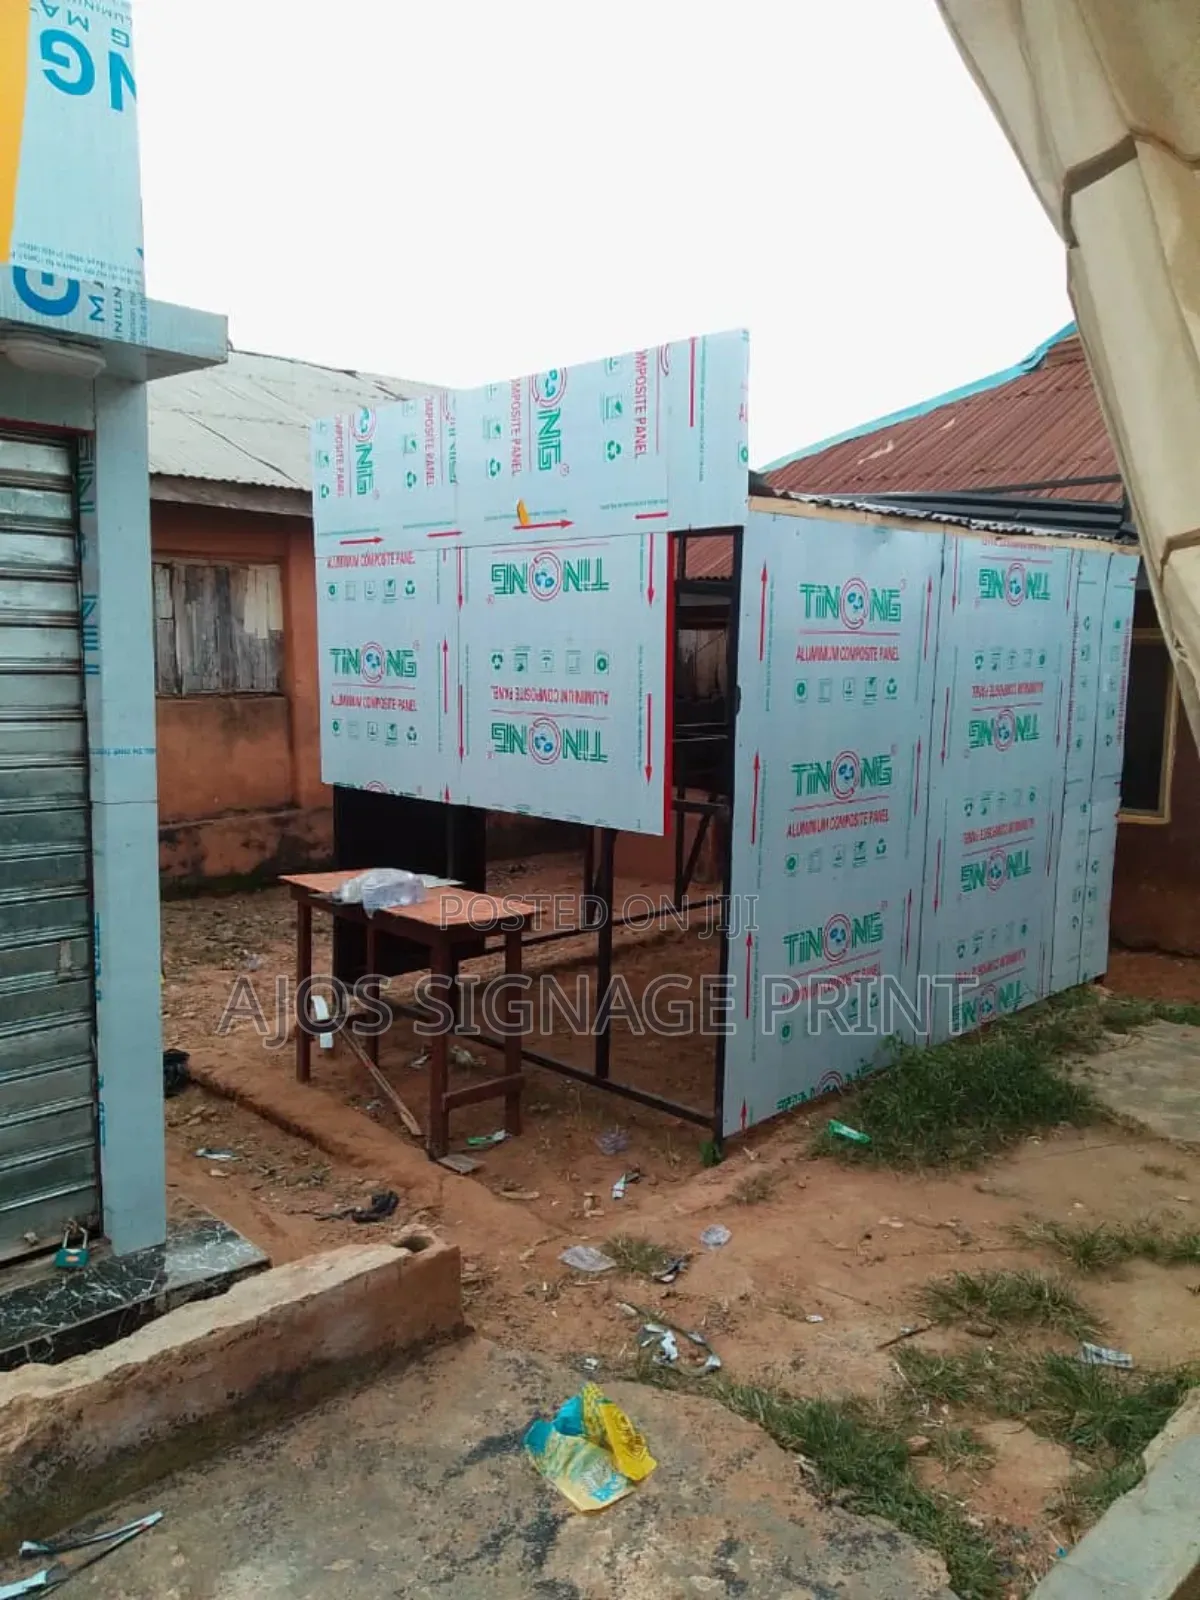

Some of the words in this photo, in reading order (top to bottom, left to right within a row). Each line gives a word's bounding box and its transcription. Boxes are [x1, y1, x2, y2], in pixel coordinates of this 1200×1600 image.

[634, 417, 648, 460] PANEL
[510, 439, 522, 476] PANEL
[515, 687, 559, 703] COMPOSITE
[561, 689, 609, 707] ALUMINIUM
[787, 818, 829, 838] ALUMINIUM
[830, 811, 868, 831] COMPOSITE
